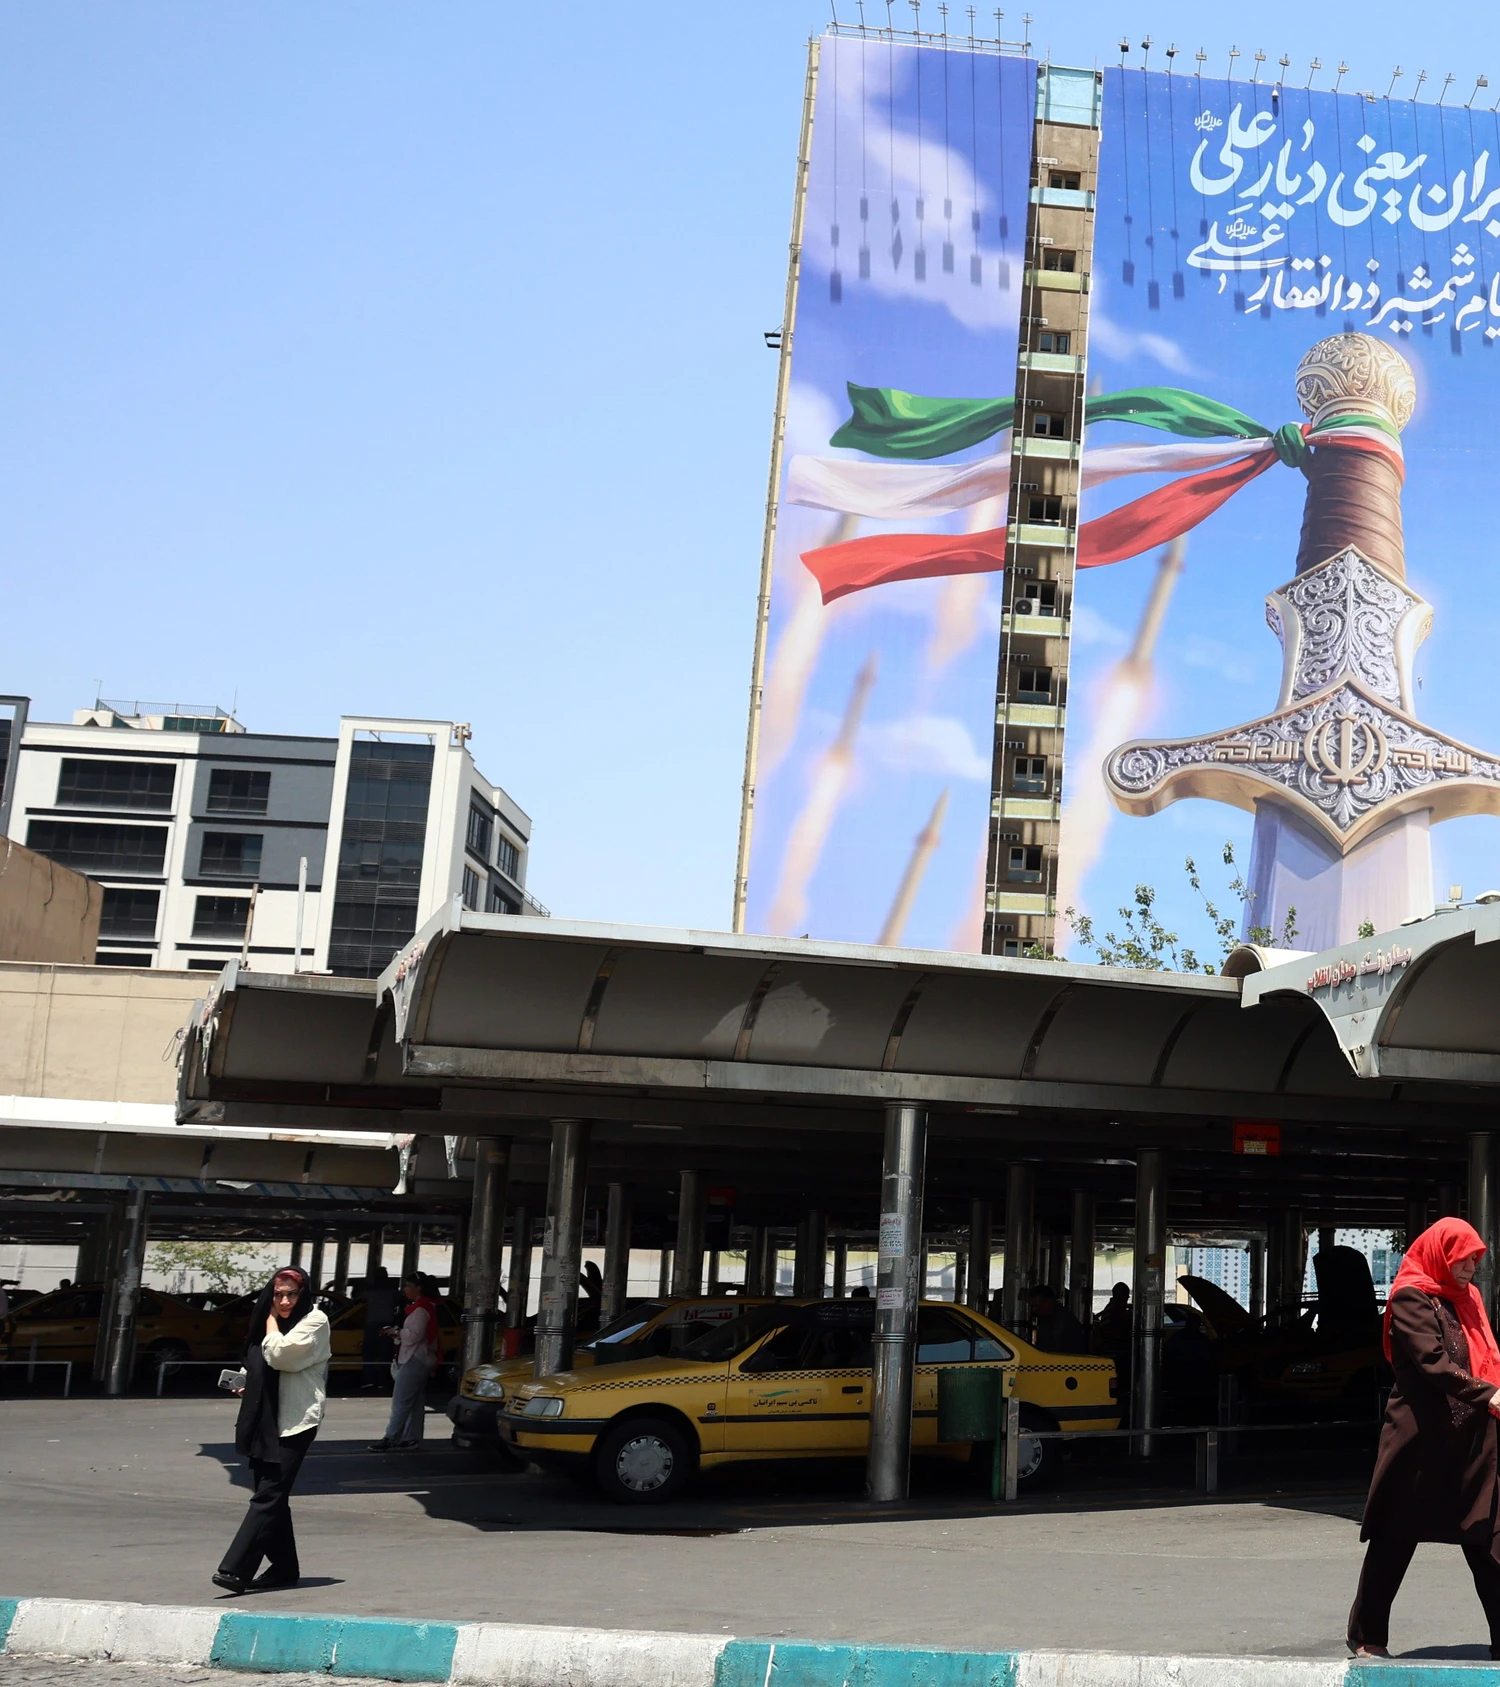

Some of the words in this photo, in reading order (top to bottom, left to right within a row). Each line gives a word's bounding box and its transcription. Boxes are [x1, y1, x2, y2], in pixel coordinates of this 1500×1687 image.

[1190, 102, 1277, 196] علی
[1327, 134, 1428, 227] یعنی
[1365, 243, 1475, 333] شمشیر
[1384, 943, 1412, 973] میدان
[1307, 964, 1332, 993] انقلاب
[1331, 960, 1357, 987] میدان
[797, 1397, 818, 1407] تاکسی
